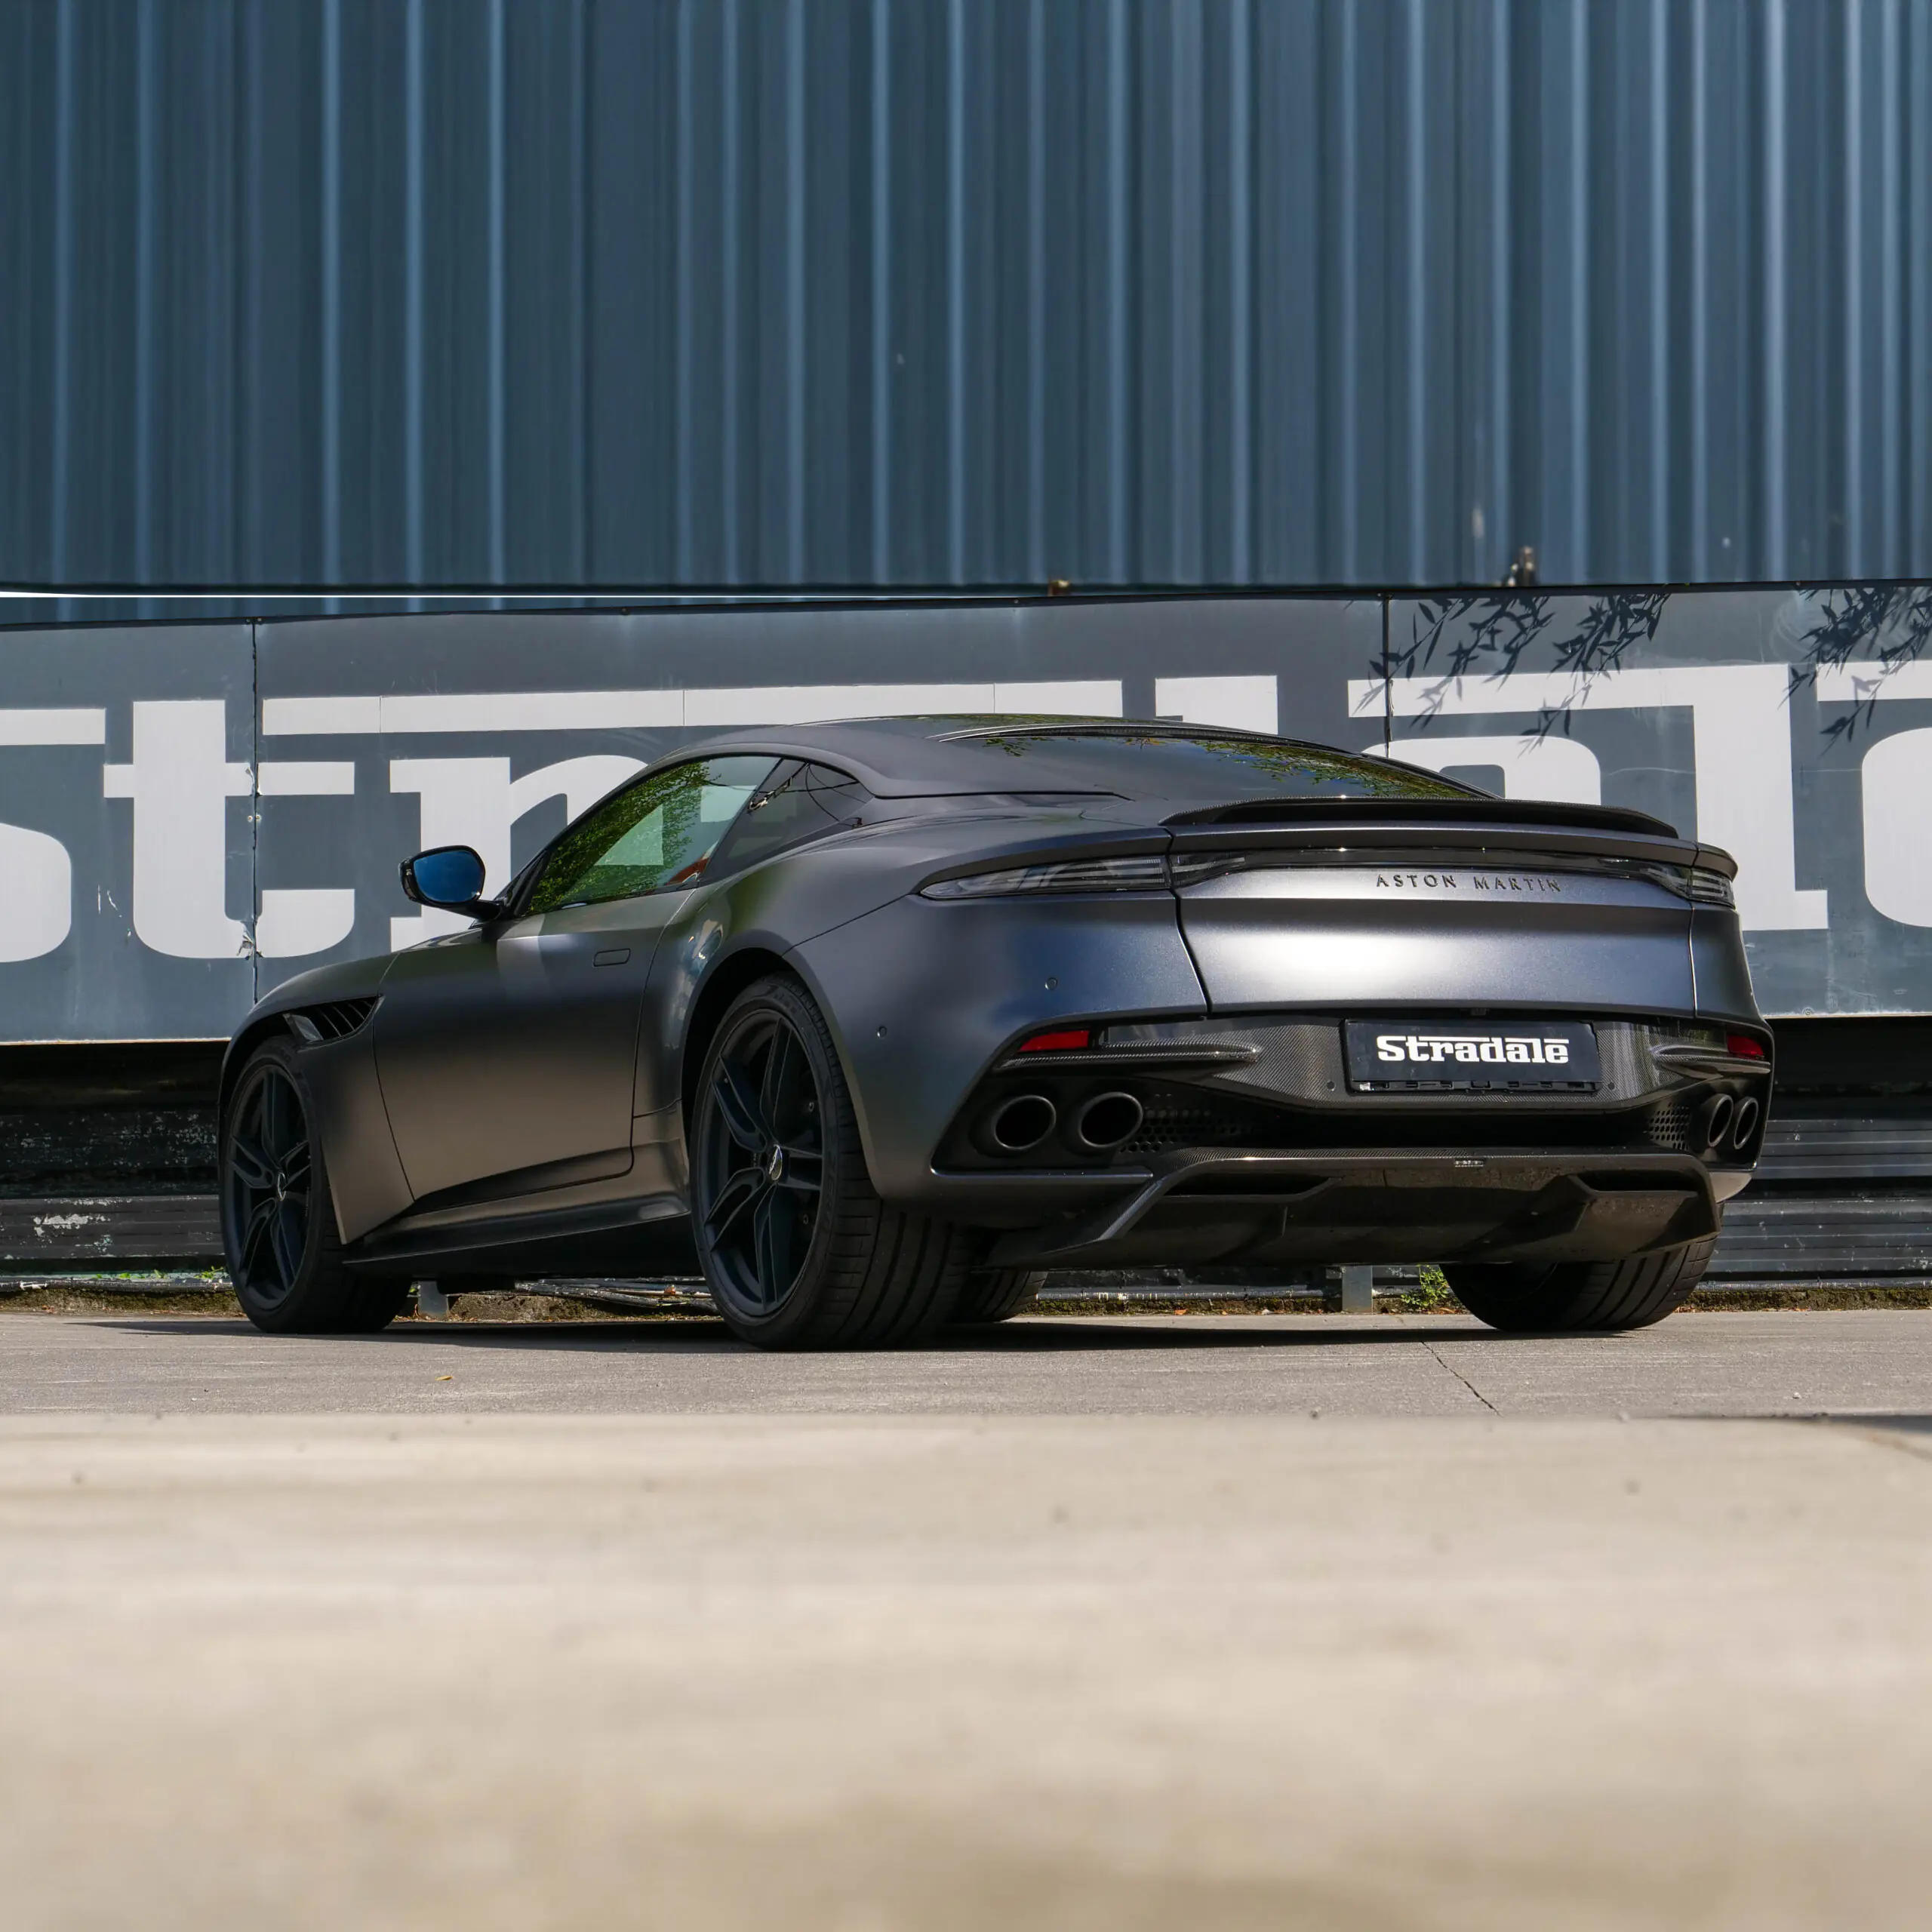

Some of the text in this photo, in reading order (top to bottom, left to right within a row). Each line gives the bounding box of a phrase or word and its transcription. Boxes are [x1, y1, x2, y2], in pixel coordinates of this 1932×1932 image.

[1377, 874, 1561, 892] ASTON MARTIN
[1377, 1035, 1569, 1063] Stradale
